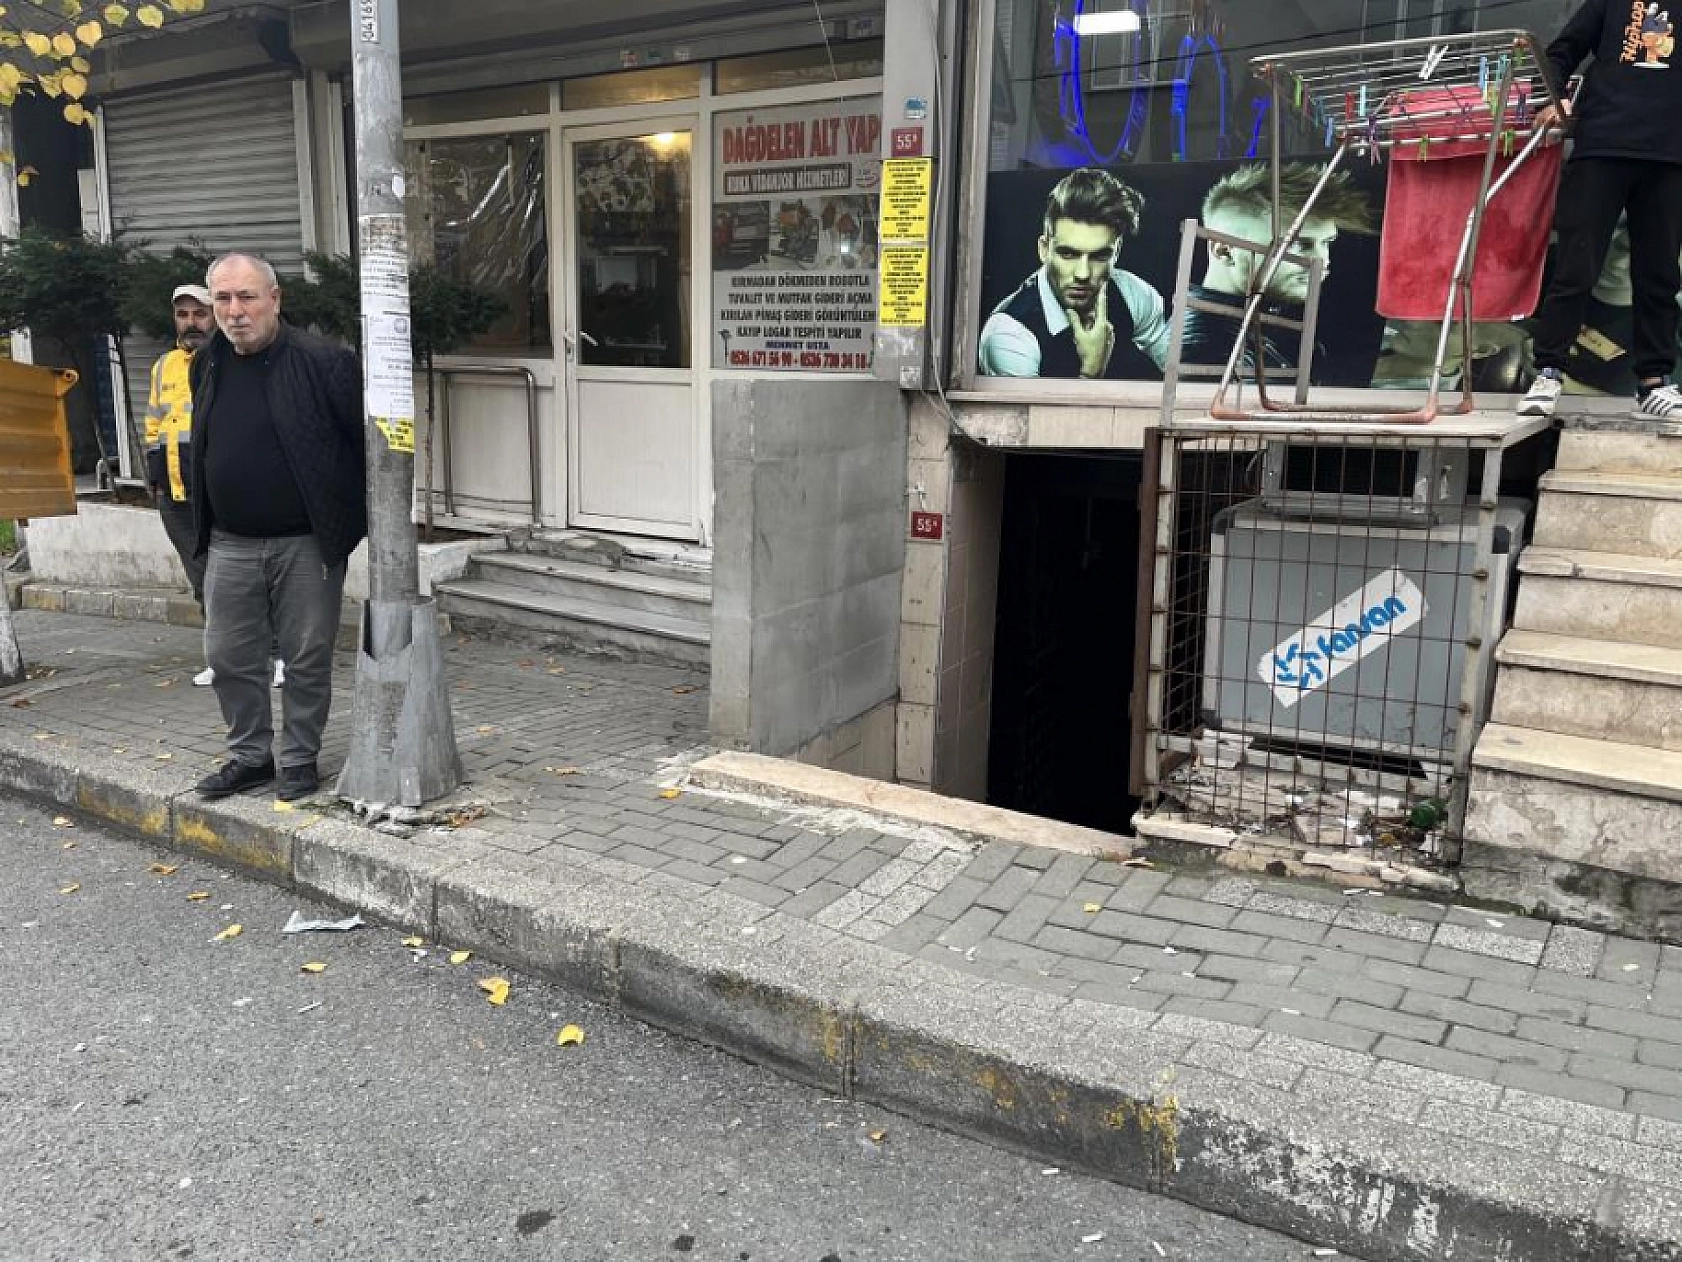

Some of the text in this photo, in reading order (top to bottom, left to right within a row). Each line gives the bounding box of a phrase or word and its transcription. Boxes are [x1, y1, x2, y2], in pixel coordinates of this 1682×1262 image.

[723, 115, 805, 164] DAĞDELEN
[810, 117, 842, 157] ALT
[829, 274, 870, 287] ROBOTLA
[729, 292, 763, 305] TUVALET
[765, 292, 776, 304] VE
[778, 292, 812, 304] MUTFAK
[848, 291, 873, 309] AÇMA
[827, 326, 862, 339] YAPILIR
